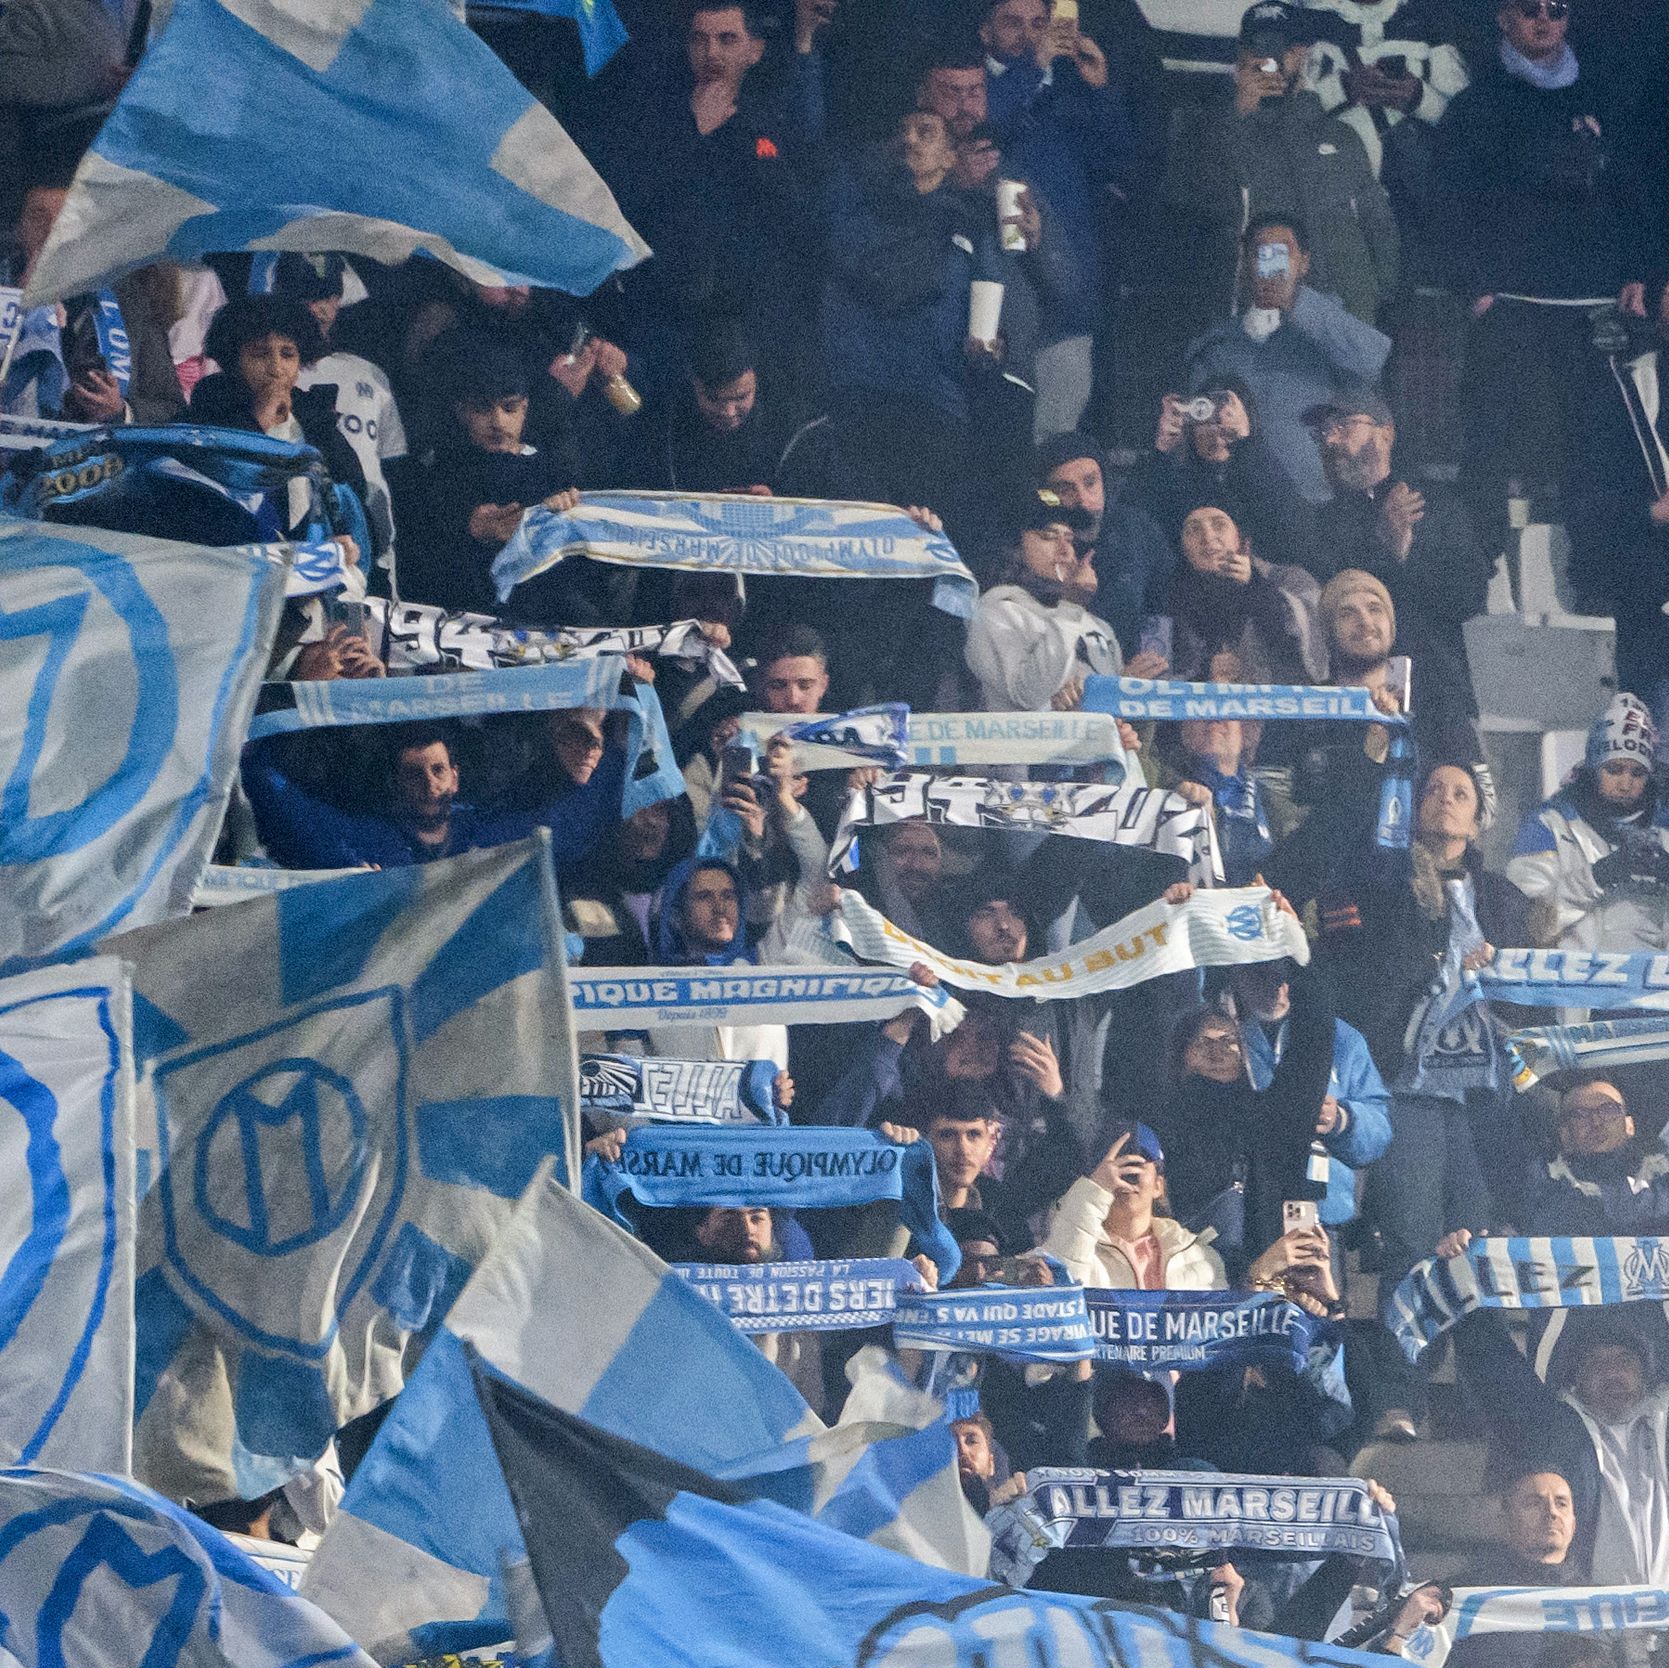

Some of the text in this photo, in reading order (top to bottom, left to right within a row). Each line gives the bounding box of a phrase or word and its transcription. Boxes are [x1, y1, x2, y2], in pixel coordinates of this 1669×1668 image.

[1119, 699, 1167, 719] DE
[961, 714, 1103, 745] MARSEILLE
[1080, 921, 1173, 979] BUT
[1127, 1305, 1299, 1343] DE MARSEILLE
[1051, 1483, 1172, 1520] ALLEZ
[1207, 1526, 1375, 1552] MARSEILLAIS
